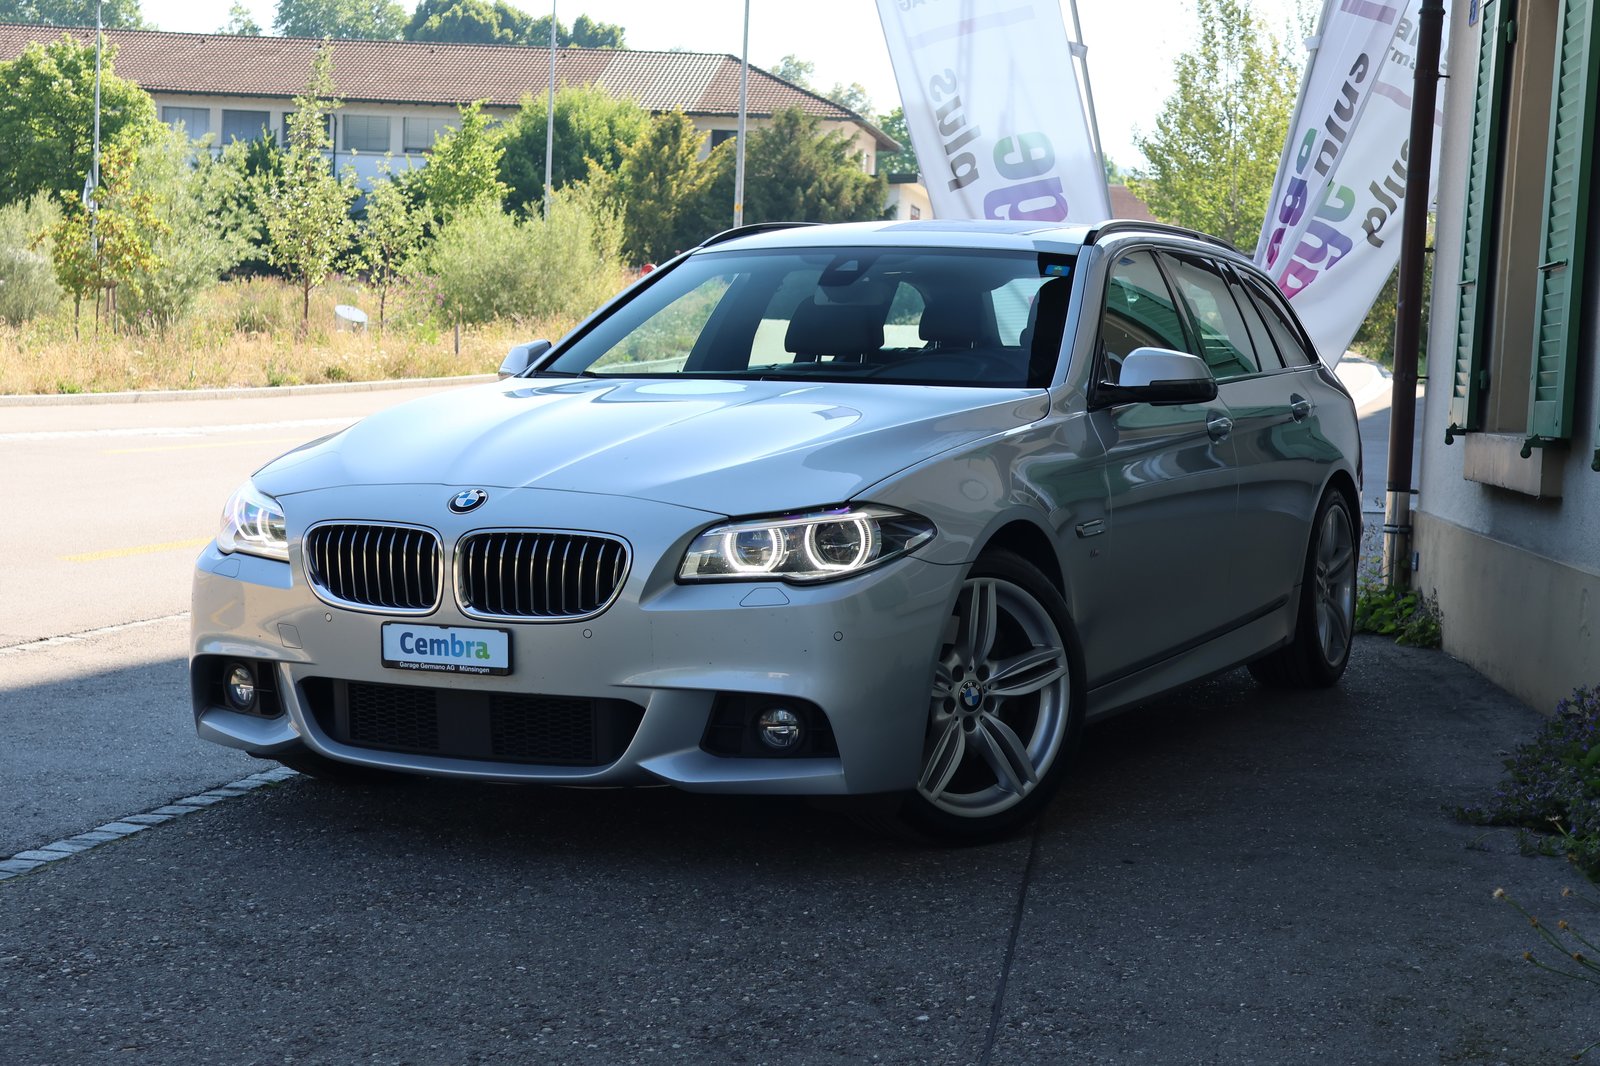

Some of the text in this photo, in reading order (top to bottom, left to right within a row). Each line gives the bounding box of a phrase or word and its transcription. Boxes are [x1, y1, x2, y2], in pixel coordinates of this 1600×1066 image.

[1314, 53, 1369, 177] plus
[400, 632, 490, 660] Cembra
[399, 662, 420, 670] Garage
[459, 665, 490, 674] Münsingen
